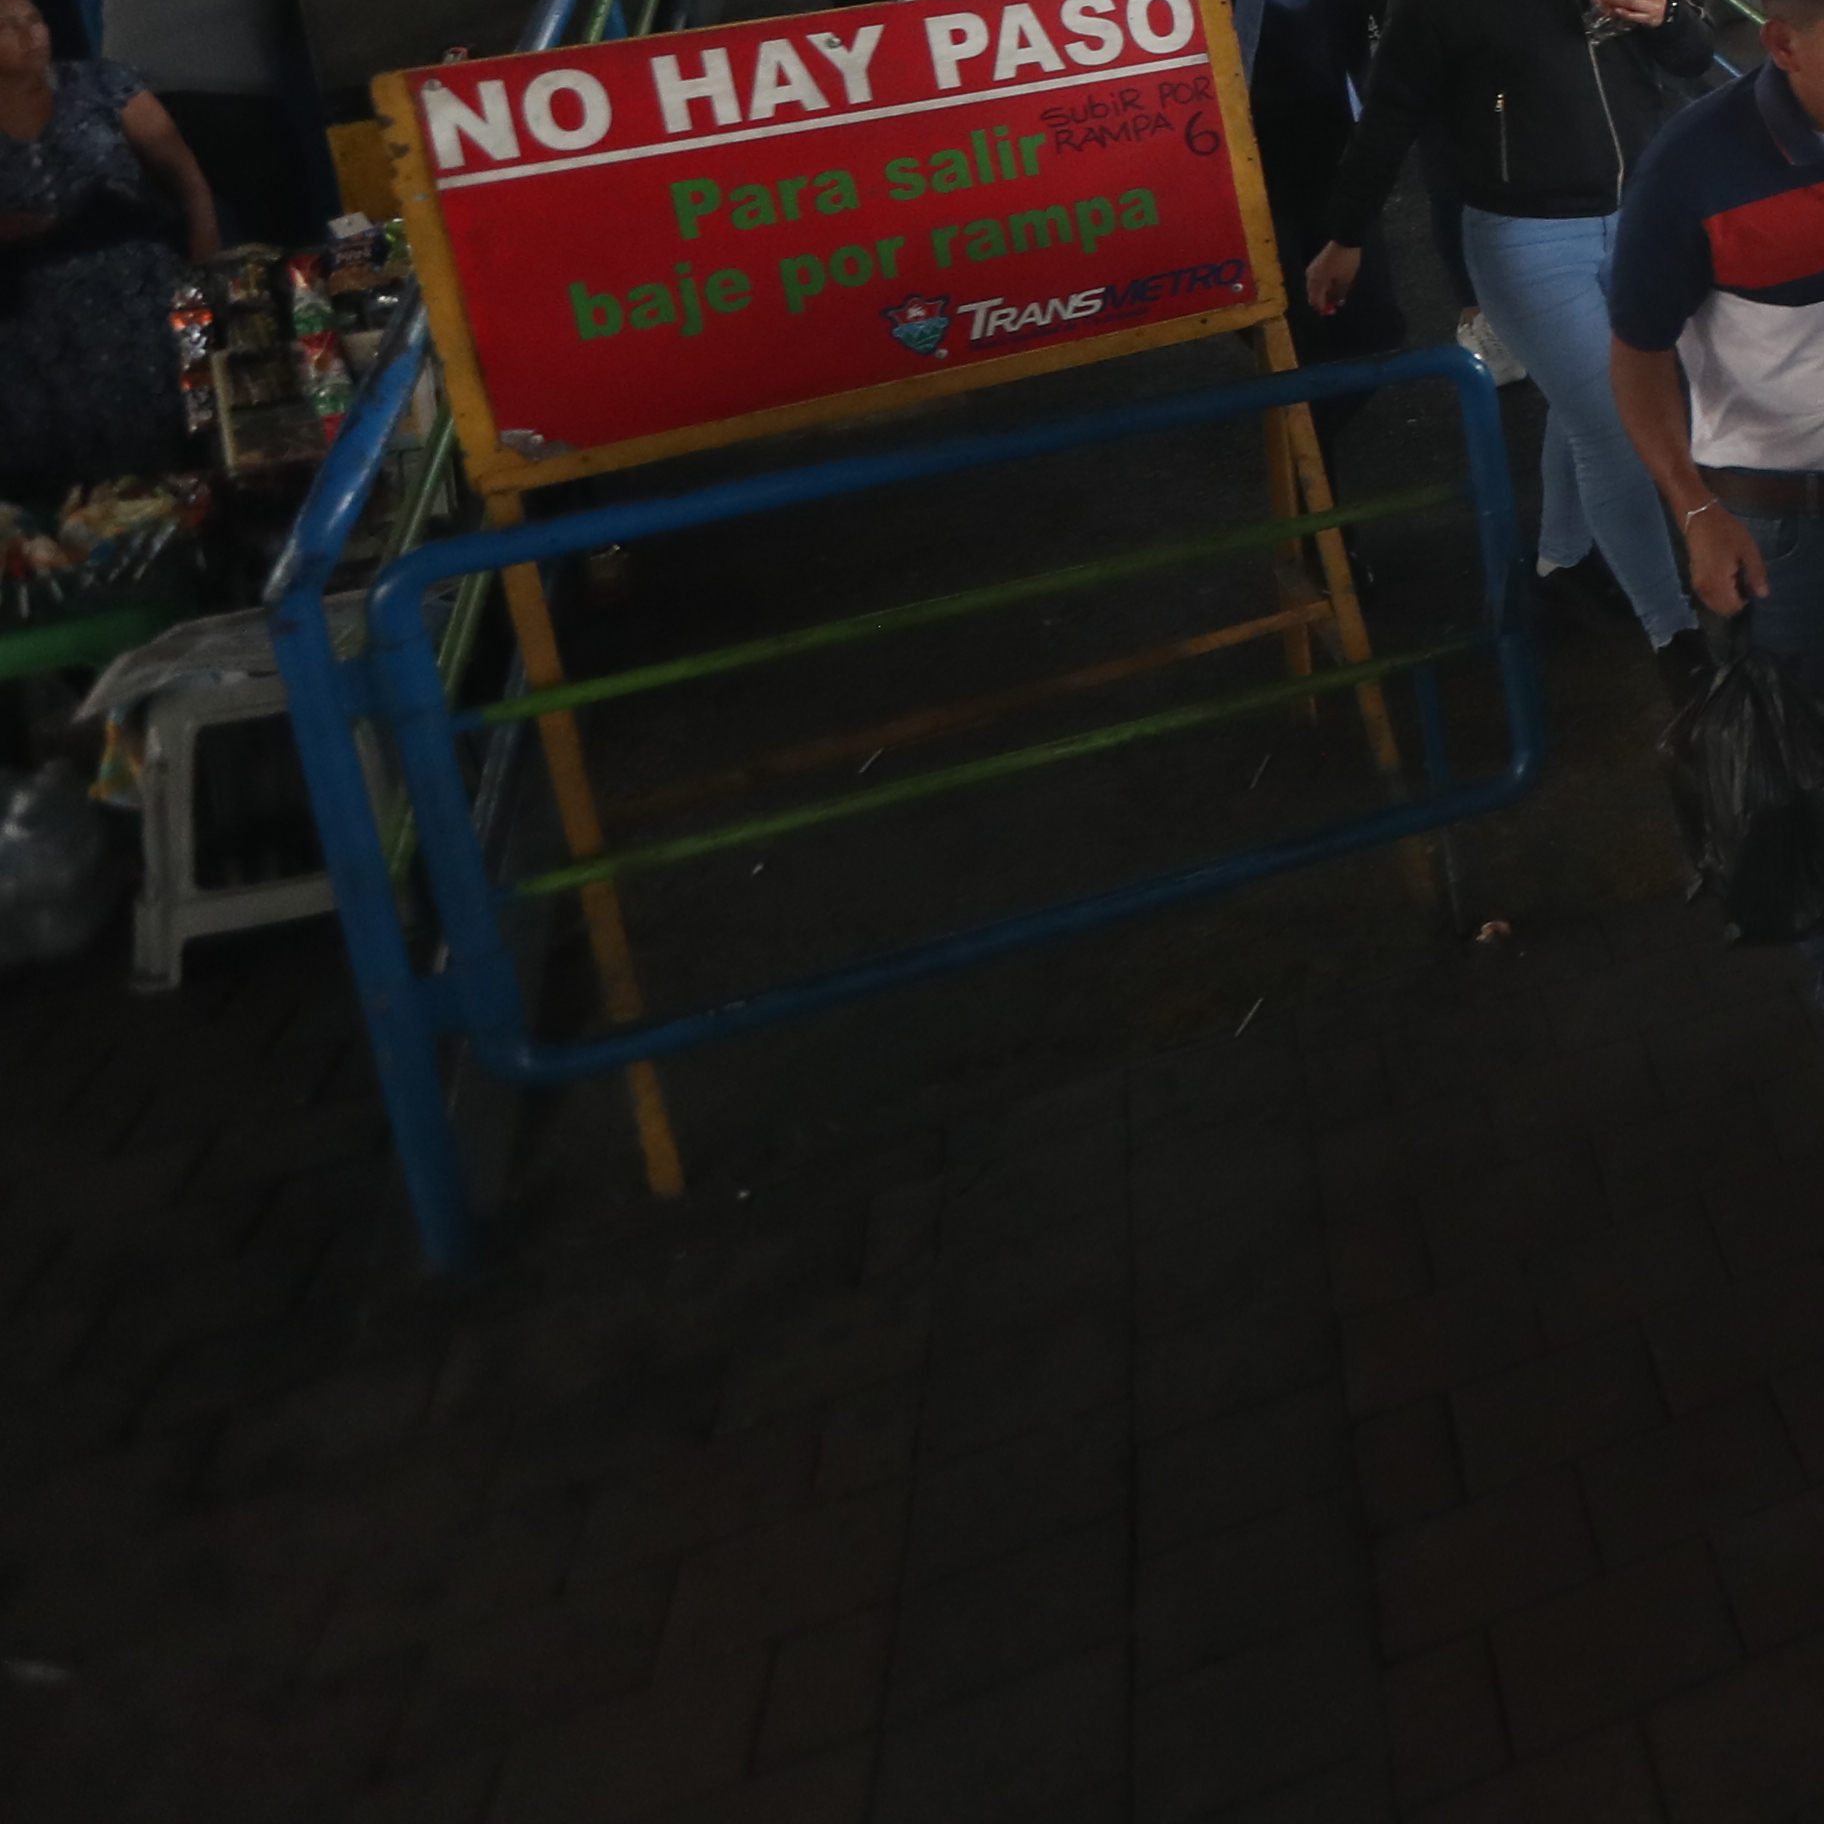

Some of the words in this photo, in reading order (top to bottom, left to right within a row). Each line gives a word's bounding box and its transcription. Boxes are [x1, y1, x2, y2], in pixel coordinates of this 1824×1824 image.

[423, 69, 611, 169] NO
[651, 24, 884, 134] HAY
[1055, 112, 1174, 155] RAMPA
[1184, 111, 1221, 156] 6
[1159, 76, 1214, 108] POR
[672, 162, 859, 240] Para
[885, 125, 1046, 201] salir
[570, 263, 751, 340] baje
[779, 234, 907, 313] por
[930, 188, 1160, 269] rampa
